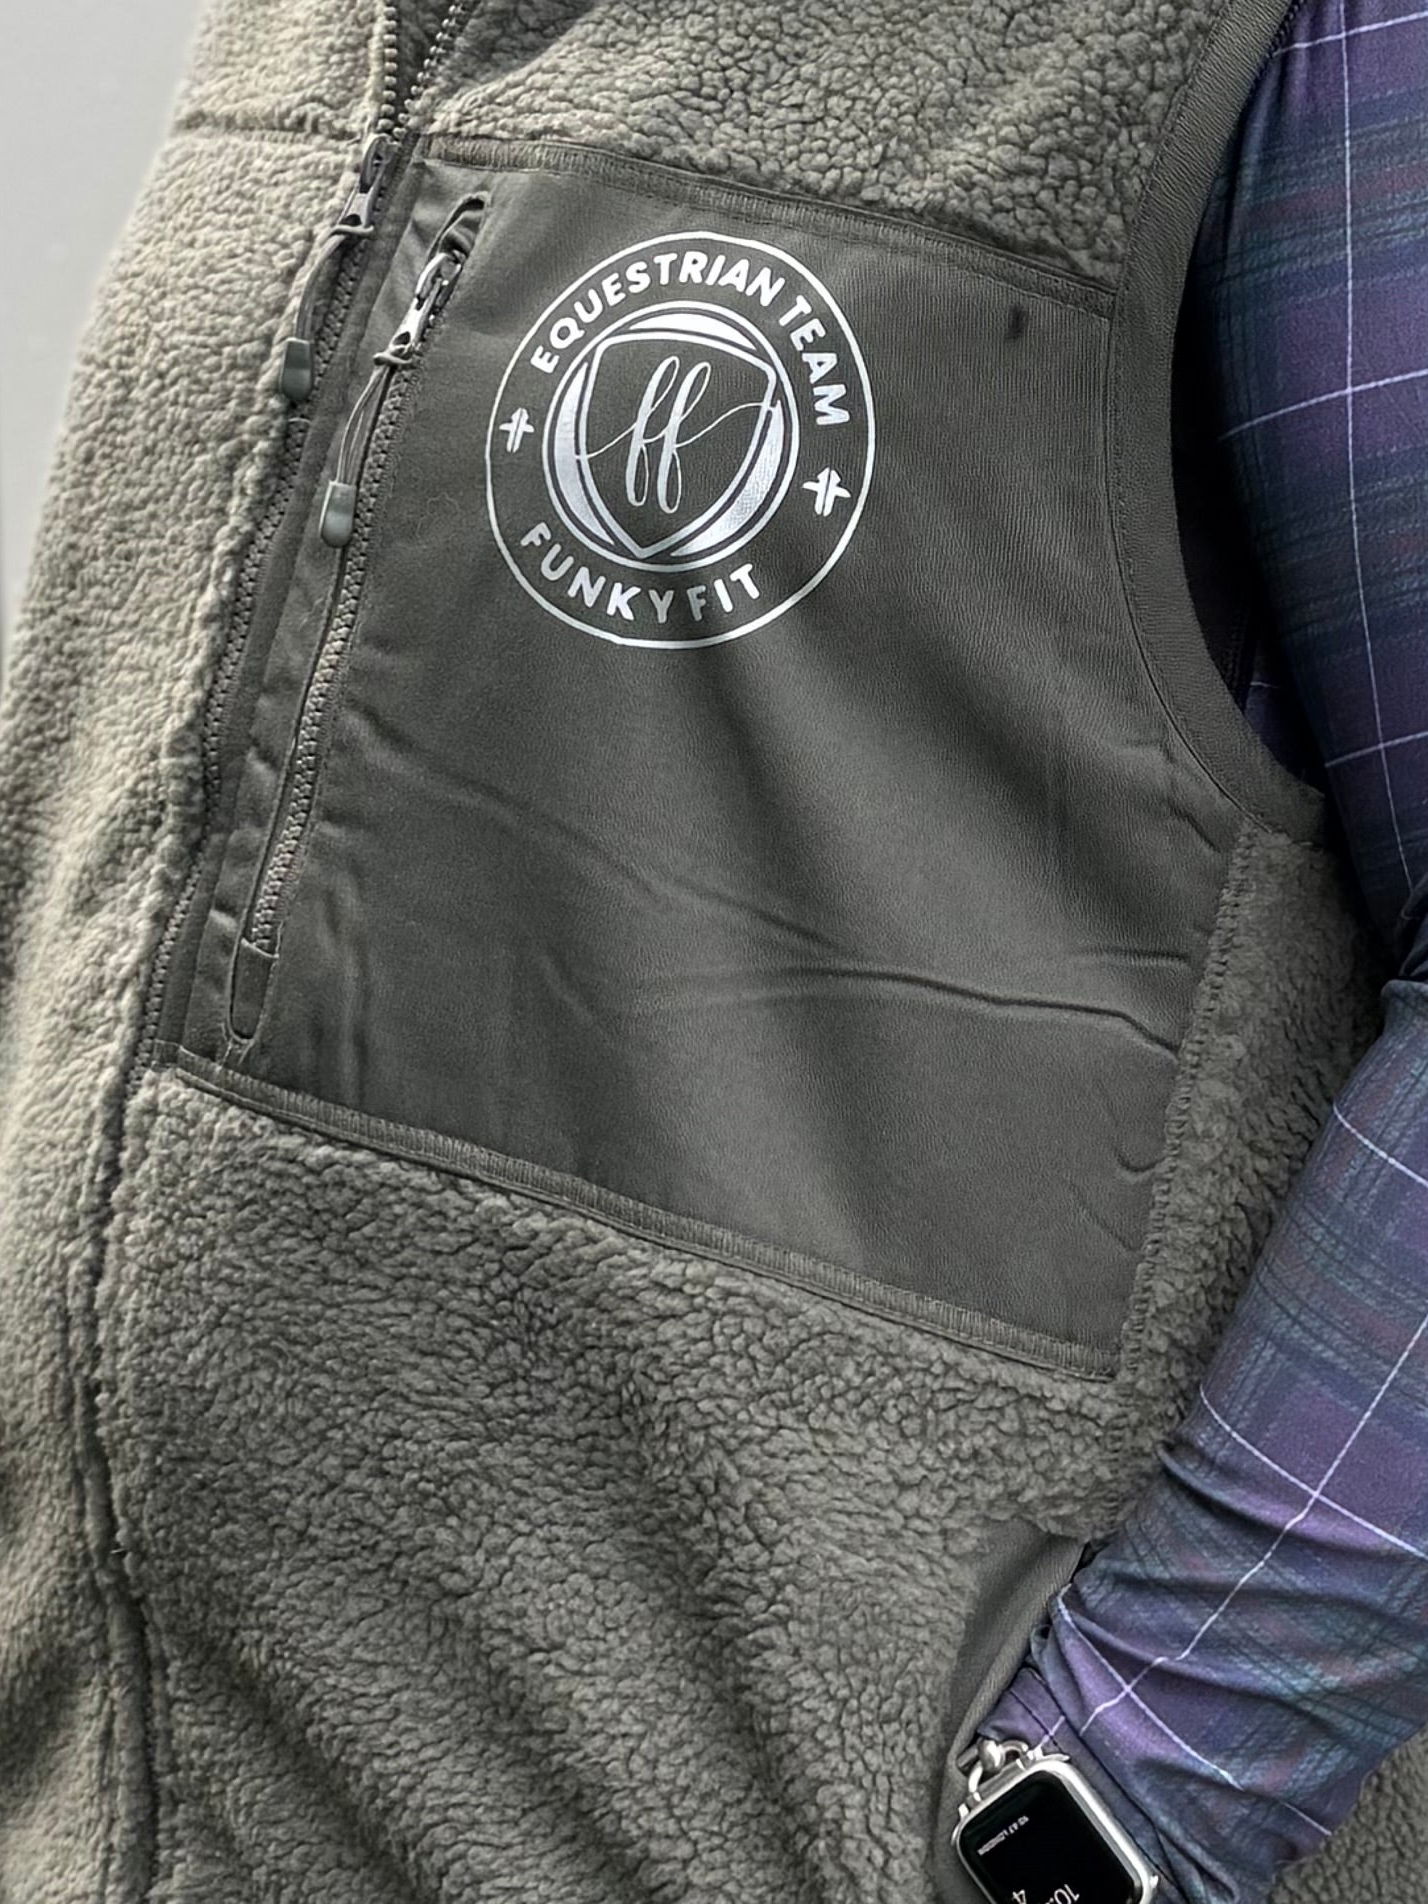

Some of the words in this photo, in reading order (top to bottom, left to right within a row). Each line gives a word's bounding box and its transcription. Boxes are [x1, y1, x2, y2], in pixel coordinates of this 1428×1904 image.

[530, 250, 785, 374] EQUESTRIAN
[778, 295, 851, 427] TEAM
[520, 521, 761, 624] FUNKYFIT
